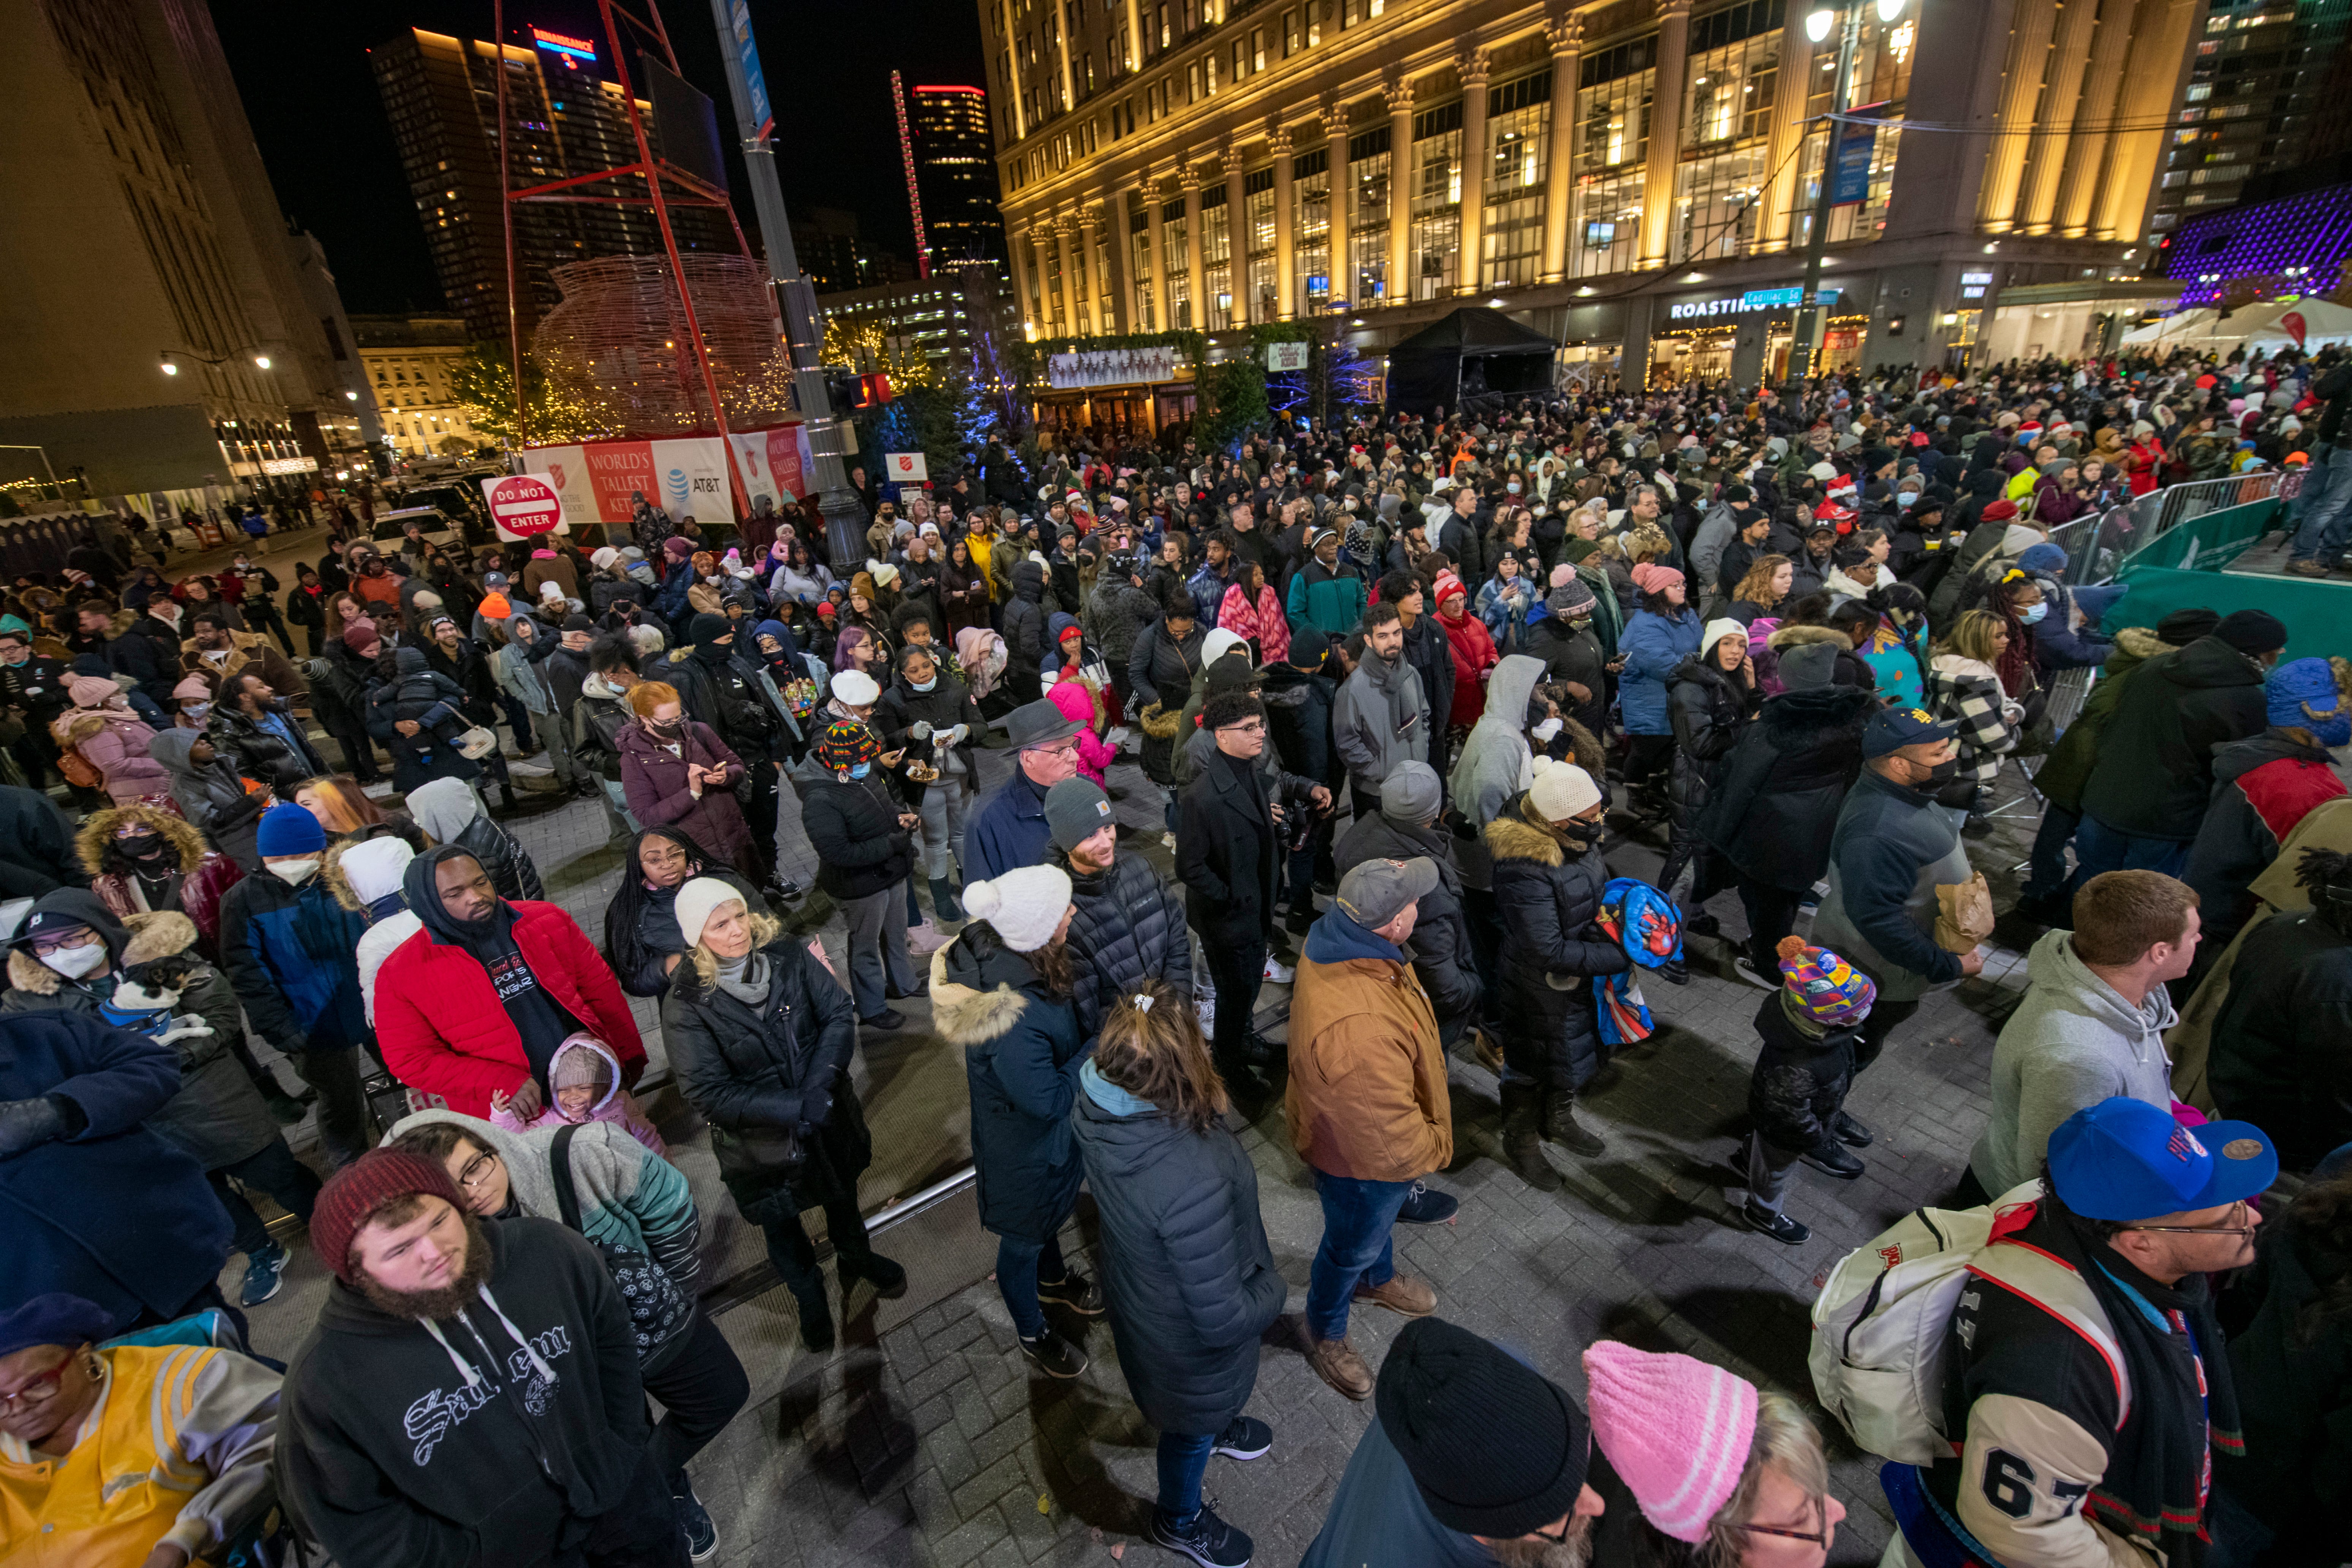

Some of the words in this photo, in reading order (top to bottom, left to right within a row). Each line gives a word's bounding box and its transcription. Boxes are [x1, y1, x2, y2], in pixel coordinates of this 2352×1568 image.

[1748, 292, 1781, 303] Cadillac
[590, 452, 649, 471] WORLD'S
[599, 476, 649, 492] TALLEST
[693, 478, 720, 493] AT&T
[496, 490, 515, 501] DO
[519, 487, 545, 499] NOT
[510, 514, 550, 528] ENTER
[1980, 1447, 2089, 1520] 67
